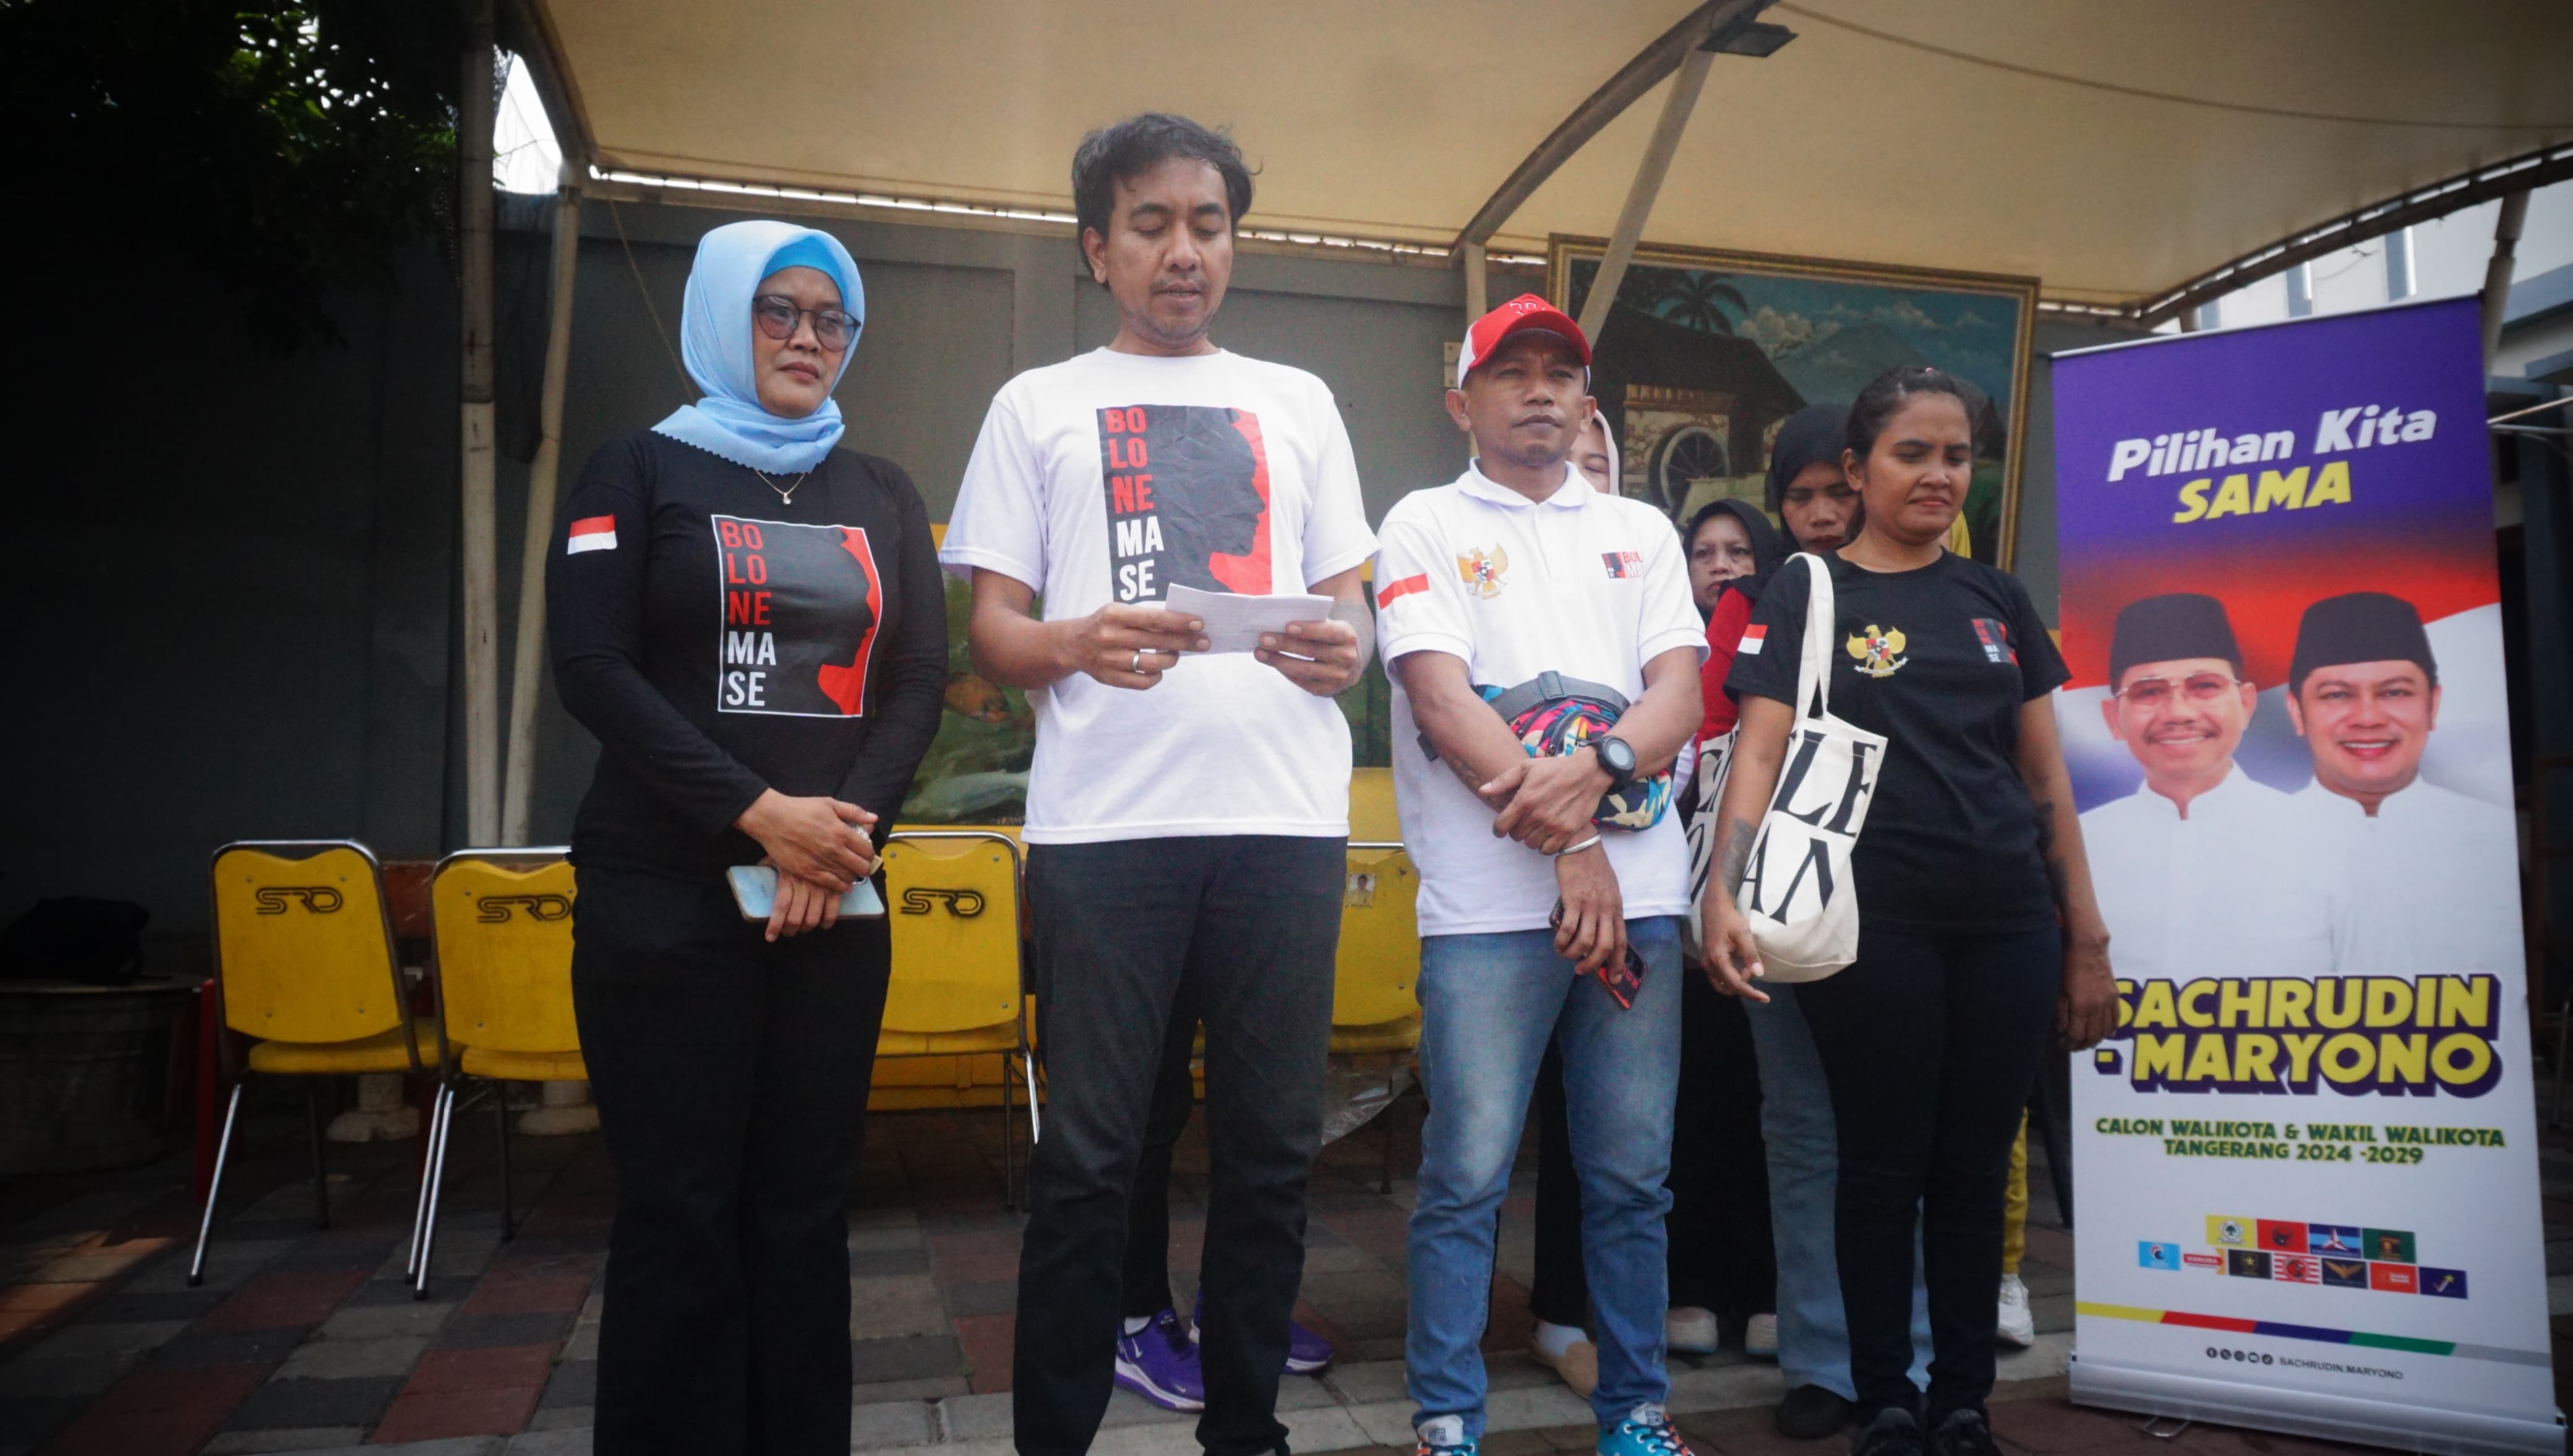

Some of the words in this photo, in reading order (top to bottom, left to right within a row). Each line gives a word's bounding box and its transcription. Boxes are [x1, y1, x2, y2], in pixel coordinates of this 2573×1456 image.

[1105, 407, 1147, 434] BO
[1108, 437, 1148, 468] LO
[2107, 427, 2295, 482] Pilihan
[2313, 405, 2437, 455] Kita
[1111, 474, 1155, 514] NE
[2172, 461, 2352, 524] SAMA
[719, 521, 763, 550] BO
[1116, 516, 1164, 557] MA
[727, 553, 768, 585] LO
[1119, 559, 1156, 601] SE
[728, 591, 771, 625] NE
[727, 631, 776, 666] MA
[726, 671, 766, 706] SE
[2131, 1032, 2496, 1090] MARYONO
[2096, 1117, 2164, 1136] CALON
[2170, 1120, 2277, 1139] WALIKOTA
[2284, 1123, 2300, 1140] &
[2307, 1123, 2377, 1142] WAKIL
[2385, 1126, 2506, 1147] WALIKOTA
[2164, 1139, 2290, 1159] TANGERANG
[2296, 1144, 2352, 1162] 2024
